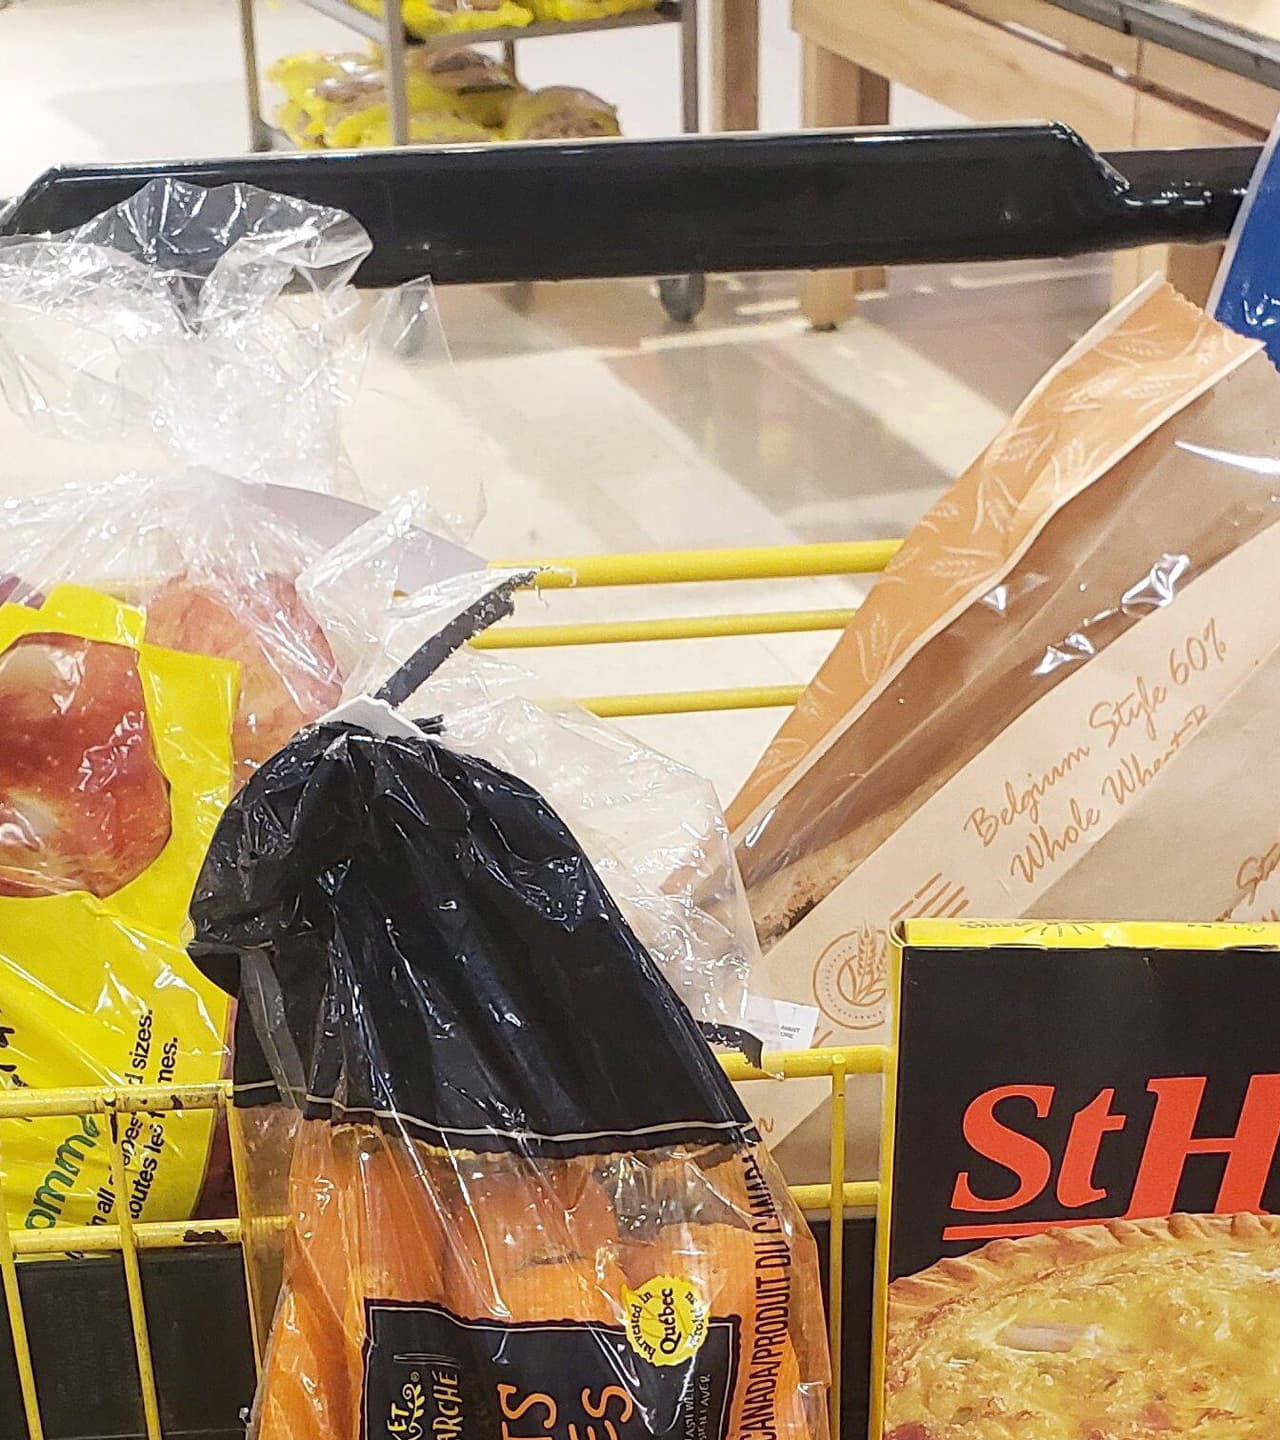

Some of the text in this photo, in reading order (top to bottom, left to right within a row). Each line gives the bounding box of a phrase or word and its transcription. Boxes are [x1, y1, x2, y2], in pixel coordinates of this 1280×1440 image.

[963, 616, 1227, 848] Belgium Style 60%
[1010, 797, 1101, 884] Whole
[132, 1008, 153, 1070] sizes.
[753, 1239, 793, 1268] DU
[658, 1287, 682, 1356] Québec
